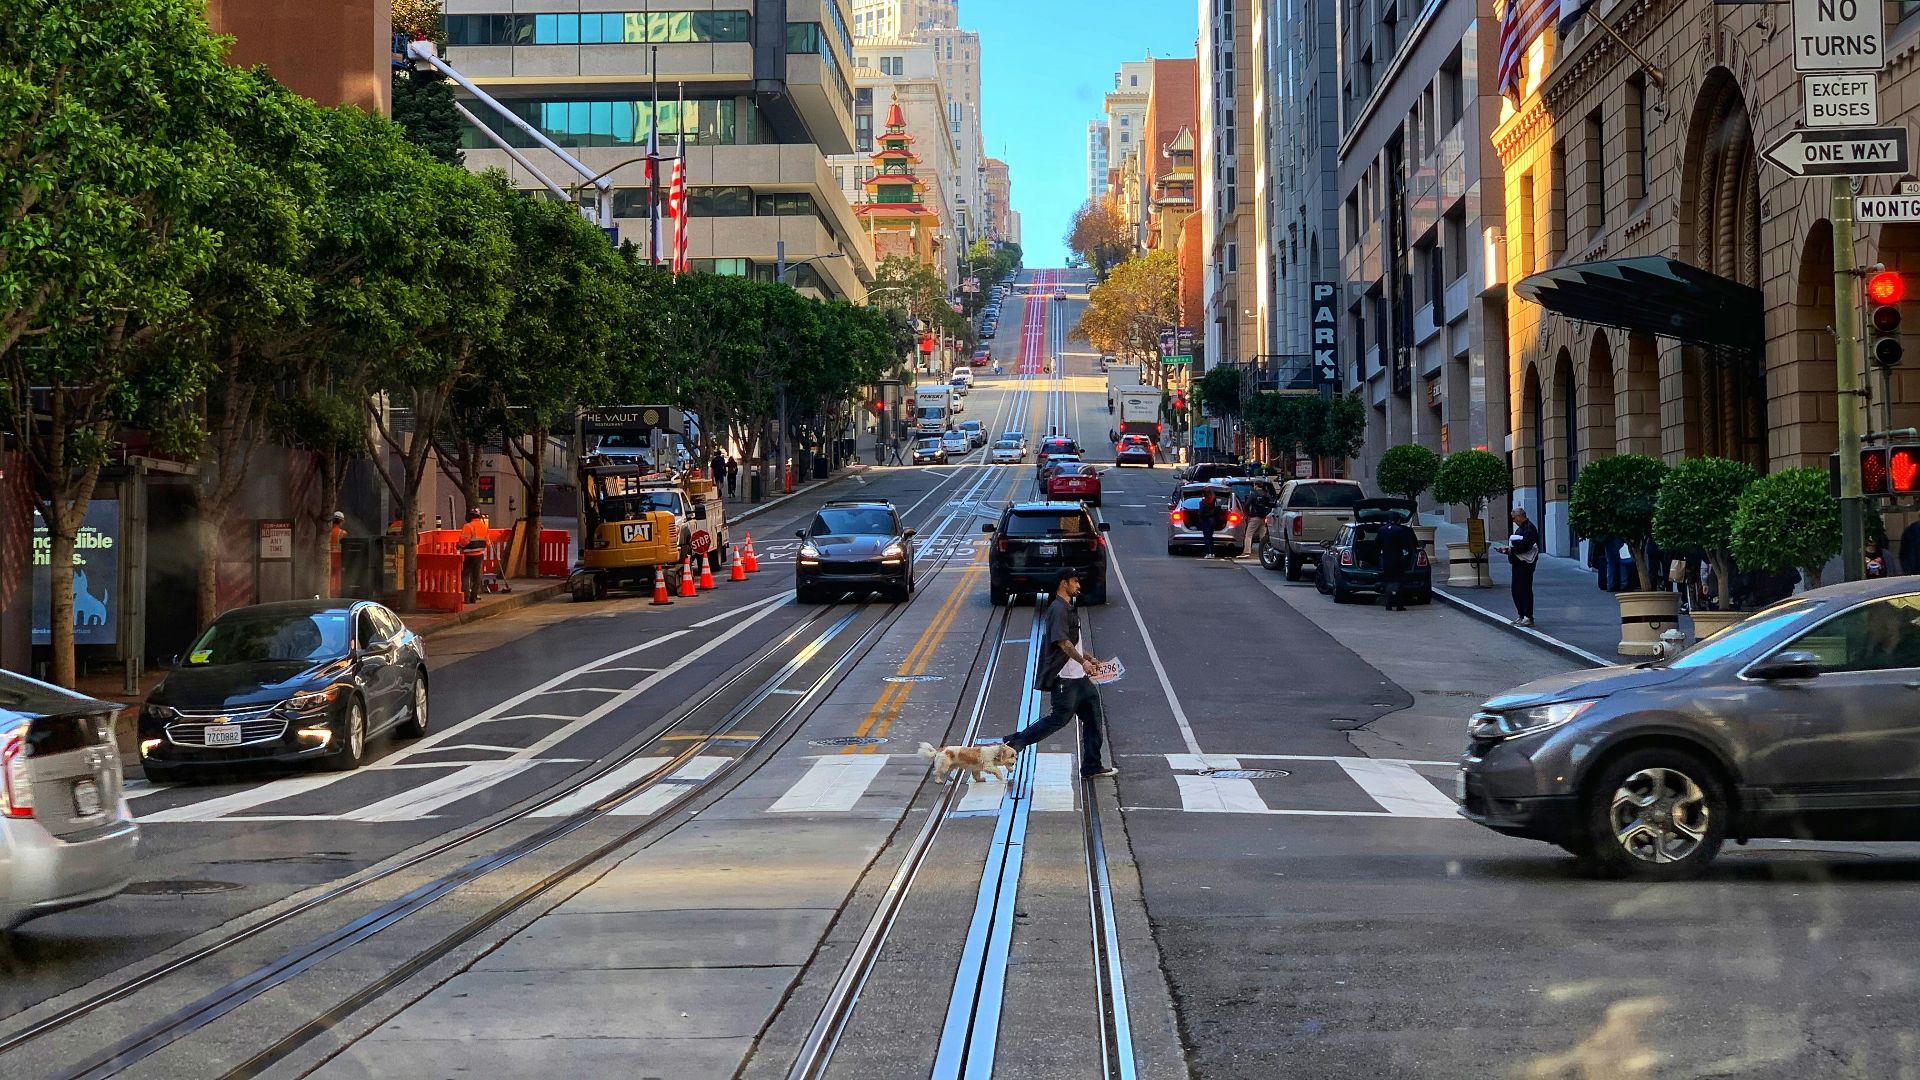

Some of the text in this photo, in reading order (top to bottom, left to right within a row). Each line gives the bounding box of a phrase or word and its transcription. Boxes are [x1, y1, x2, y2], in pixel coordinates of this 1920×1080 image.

[1818, 0, 1857, 22] NO
[1801, 35, 1877, 57] TURNS
[1813, 82, 1868, 97] EXCEPT
[1813, 103, 1870, 117] BUSES
[1804, 142, 1891, 162] ONE WAY
[1861, 200, 1920, 218] MONTG
[1314, 284, 1336, 366] PARK
[584, 413, 638, 422] HE VAULT
[262, 529, 270, 537] NO
[623, 524, 650, 542] CAT
[691, 534, 710, 550] STOP
